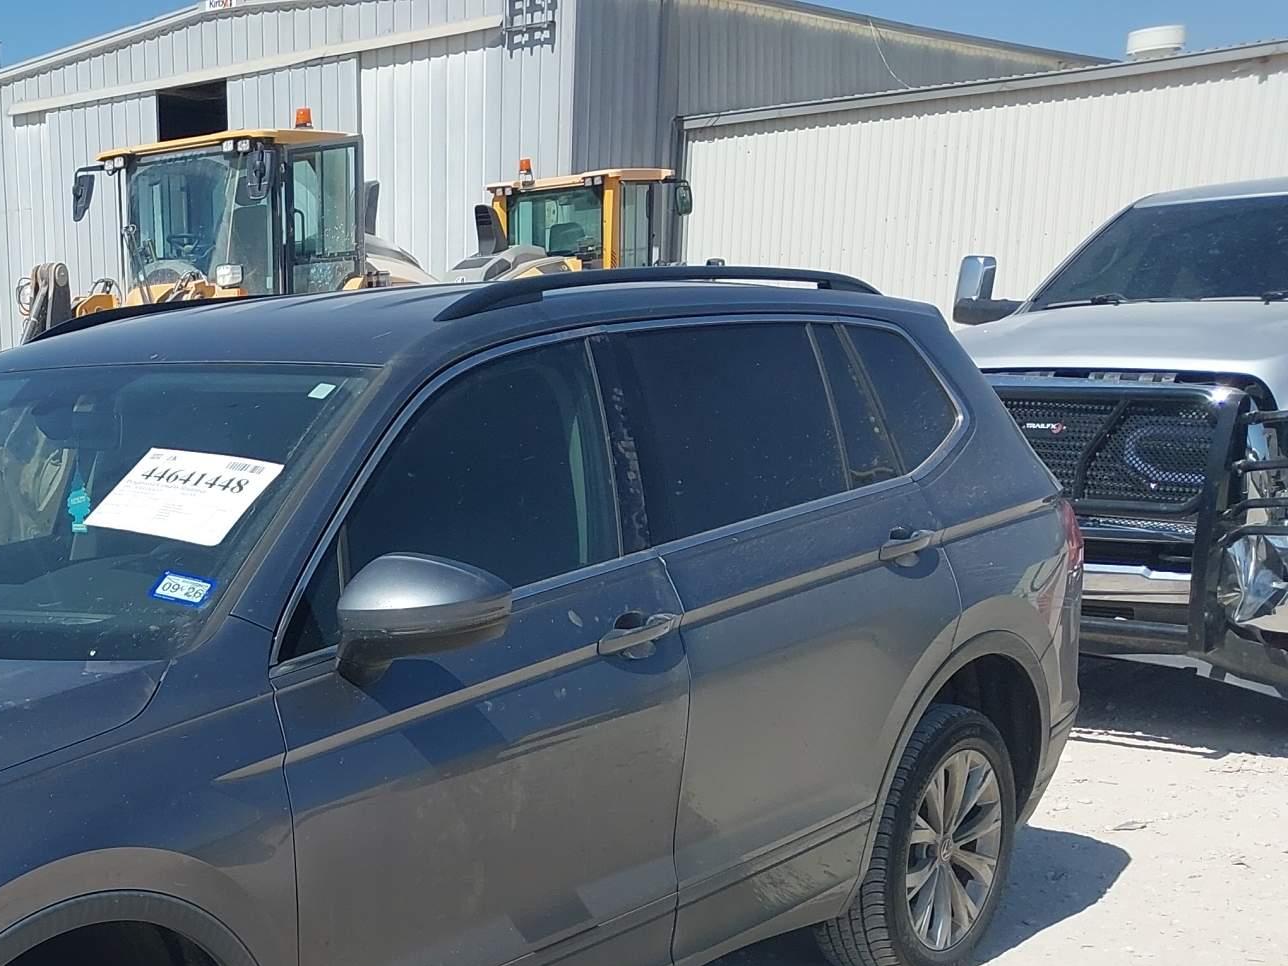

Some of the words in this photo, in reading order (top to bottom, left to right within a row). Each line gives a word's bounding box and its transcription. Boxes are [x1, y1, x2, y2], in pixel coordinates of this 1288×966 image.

[140, 466, 250, 494] 44641448
[162, 582, 180, 593] 09
[184, 586, 204, 599] 26
